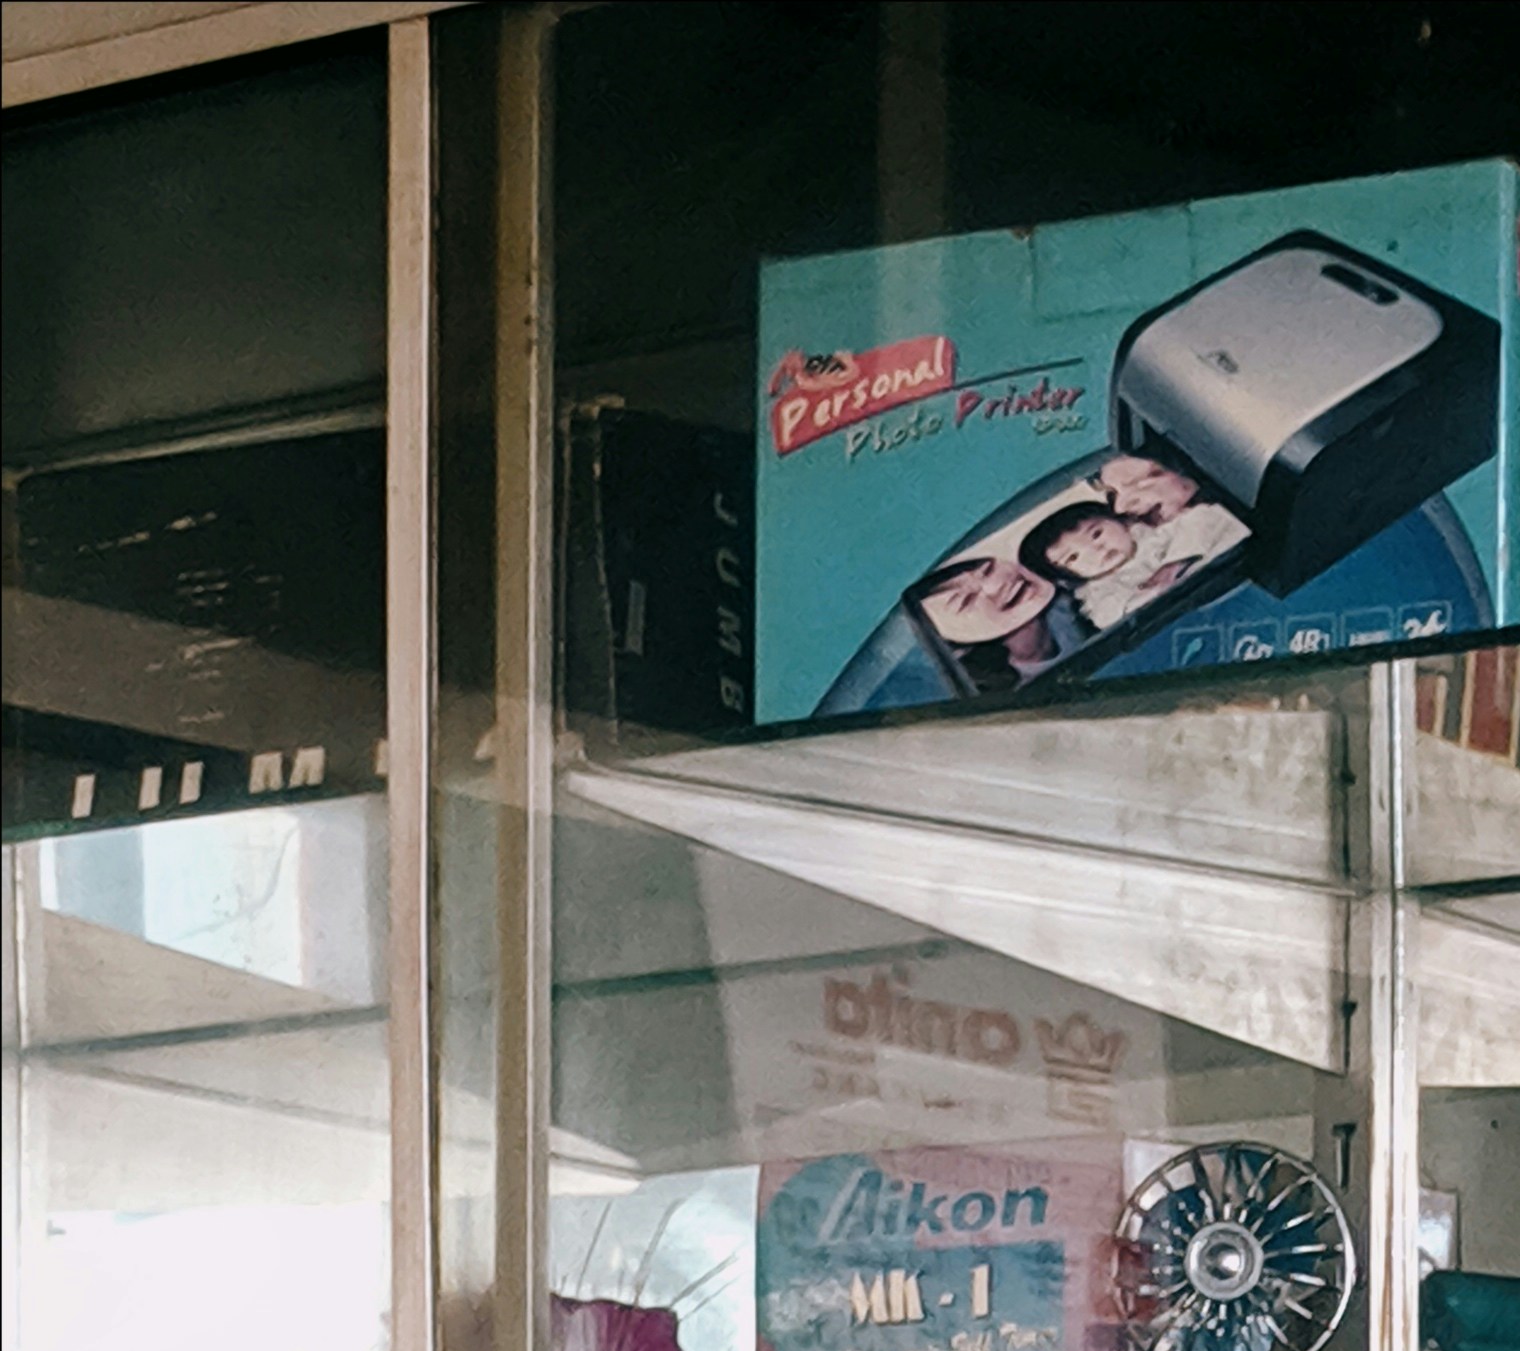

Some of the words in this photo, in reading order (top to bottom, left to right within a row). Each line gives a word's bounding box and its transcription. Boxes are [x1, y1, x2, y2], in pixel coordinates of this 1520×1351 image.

[781, 336, 946, 447] Personal
[847, 408, 944, 462] Photo
[955, 376, 1086, 428] Printer
